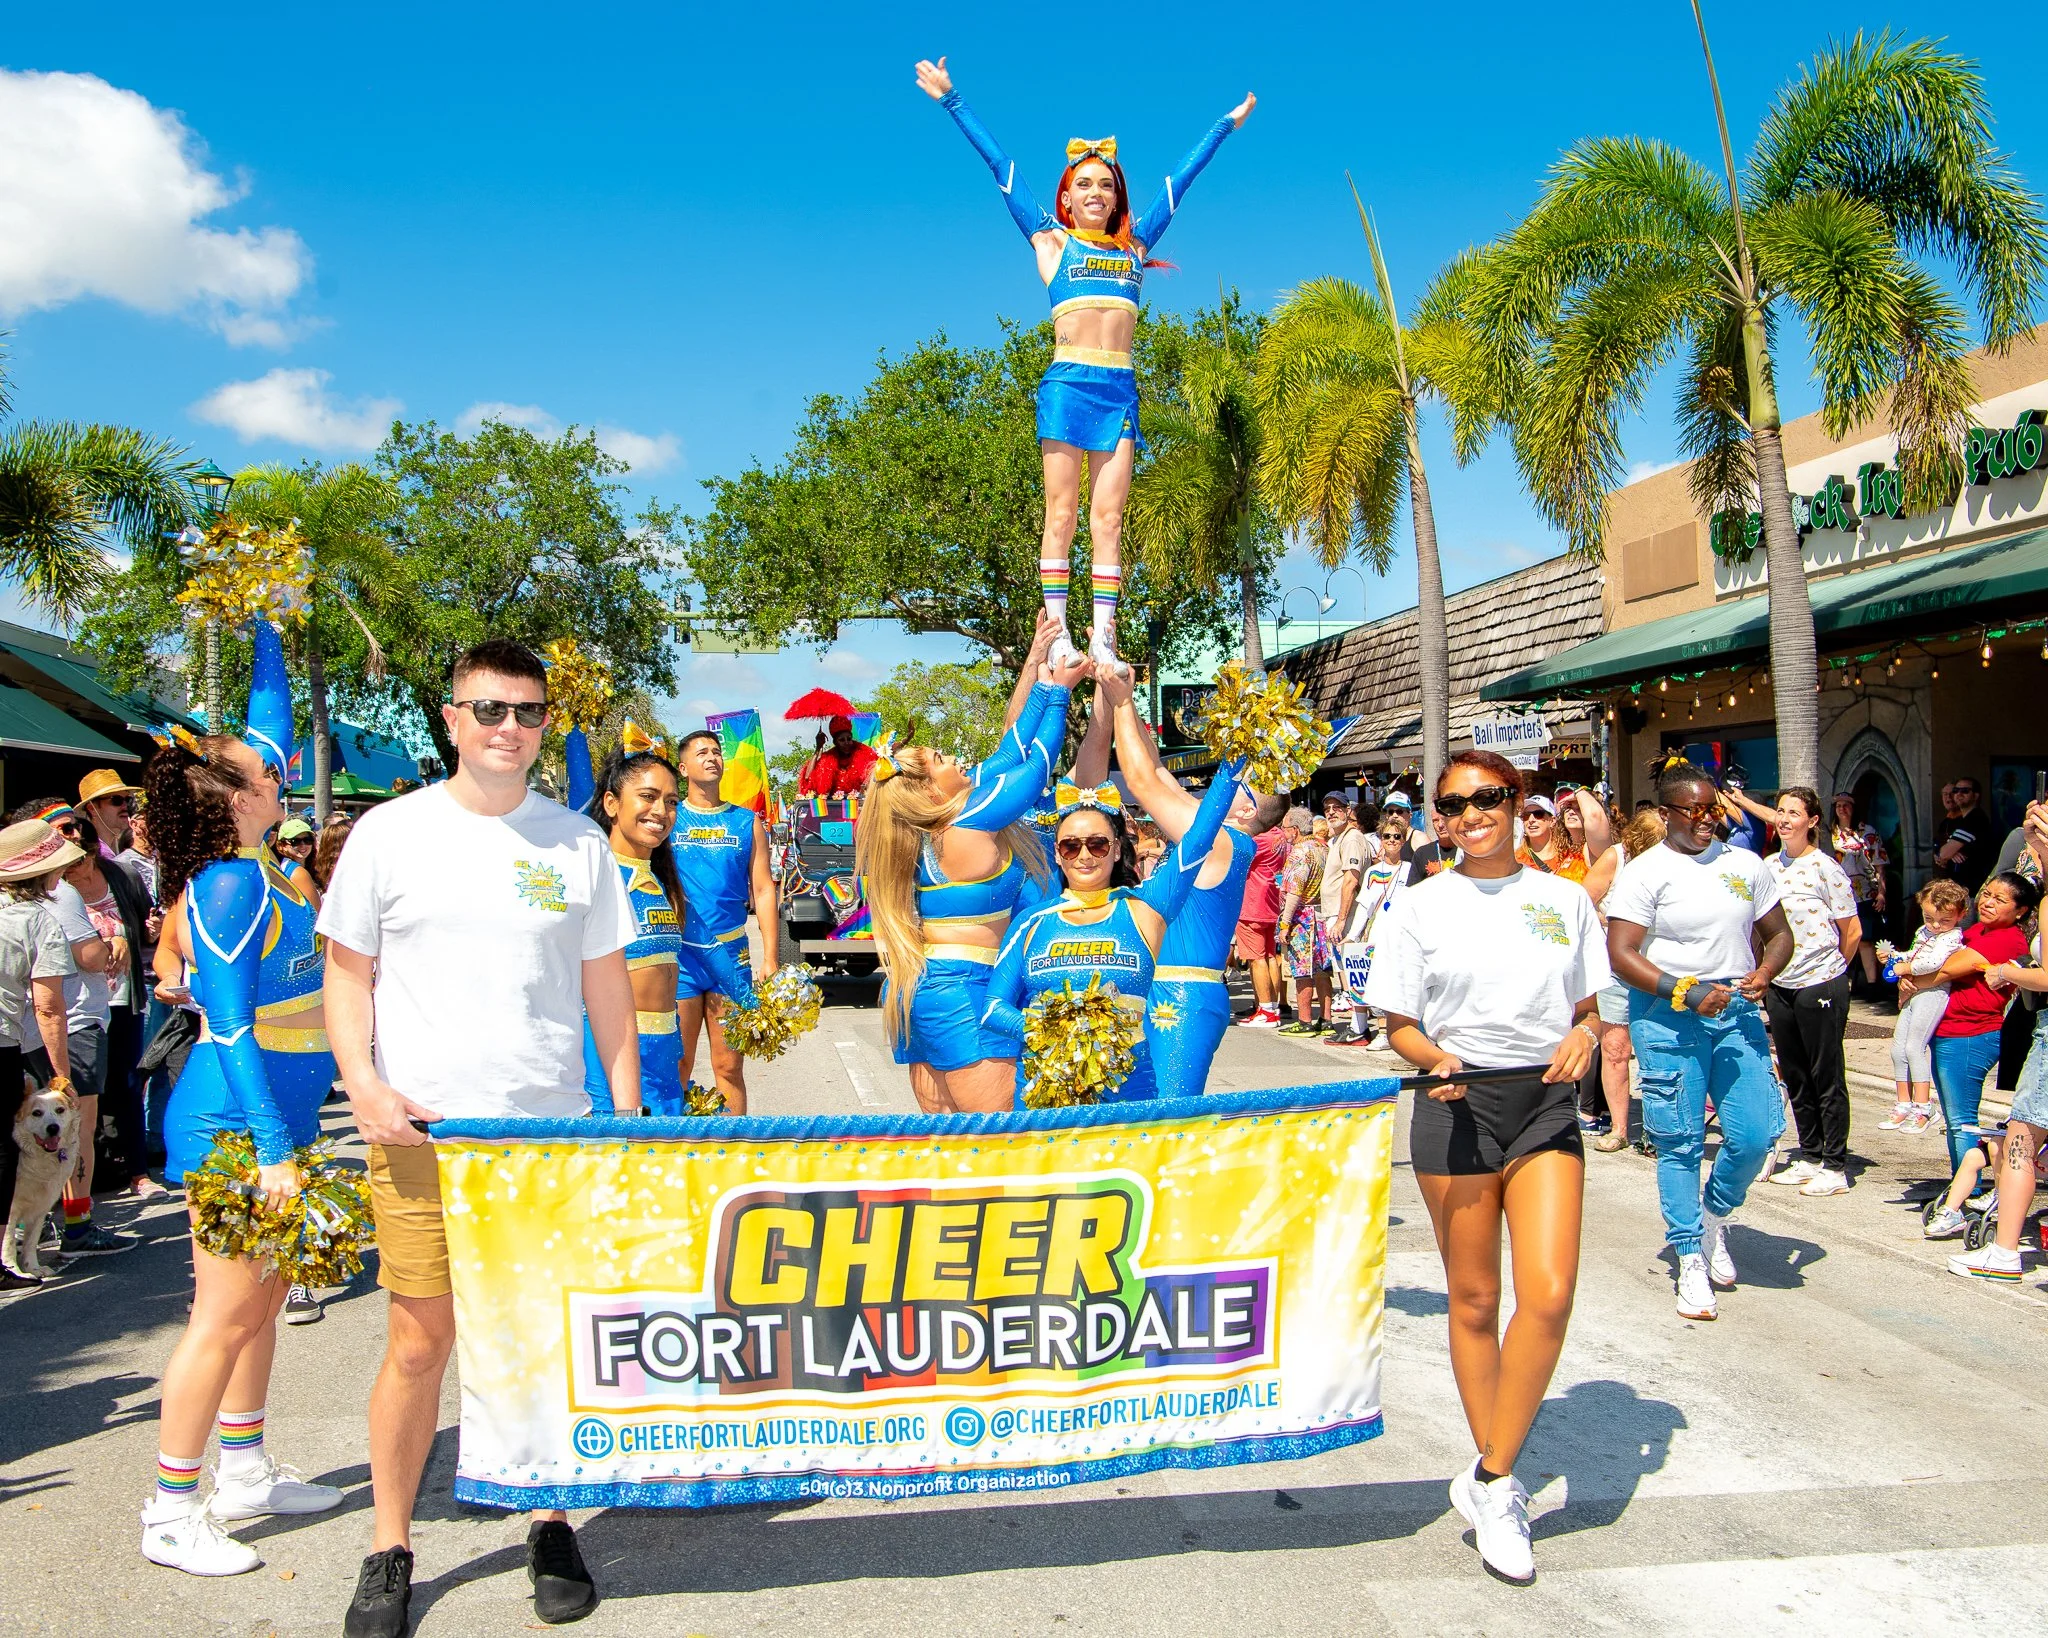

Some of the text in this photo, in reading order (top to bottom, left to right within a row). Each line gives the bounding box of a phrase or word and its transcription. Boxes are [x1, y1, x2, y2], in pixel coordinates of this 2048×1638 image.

[1086, 257, 1132, 272] CHEER
[1072, 268, 1142, 281] FORT LAUDERDALE
[1964, 408, 2043, 486] Pub
[1474, 719, 1543, 746] Bali Importers
[689, 828, 726, 839] CHEER
[830, 828, 844, 838] 22
[541, 901, 569, 912] FAN
[648, 910, 678, 925] CHEE
[641, 924, 657, 935] ORT
[1049, 940, 1115, 957] CHEER
[1032, 954, 1136, 969] FORT LAUDERDALE
[1345, 957, 1371, 971] Andy
[729, 1192, 1130, 1308] CHEER
[597, 1285, 1253, 1384] FORT LAUDERDALE
[619, 1381, 1279, 1451] CHEERFORTLAUDERDALE.ORG @CHEERFORTLAUDERDALE
[799, 1472, 1071, 1501] 501(c)3 Nonprofit Organization
